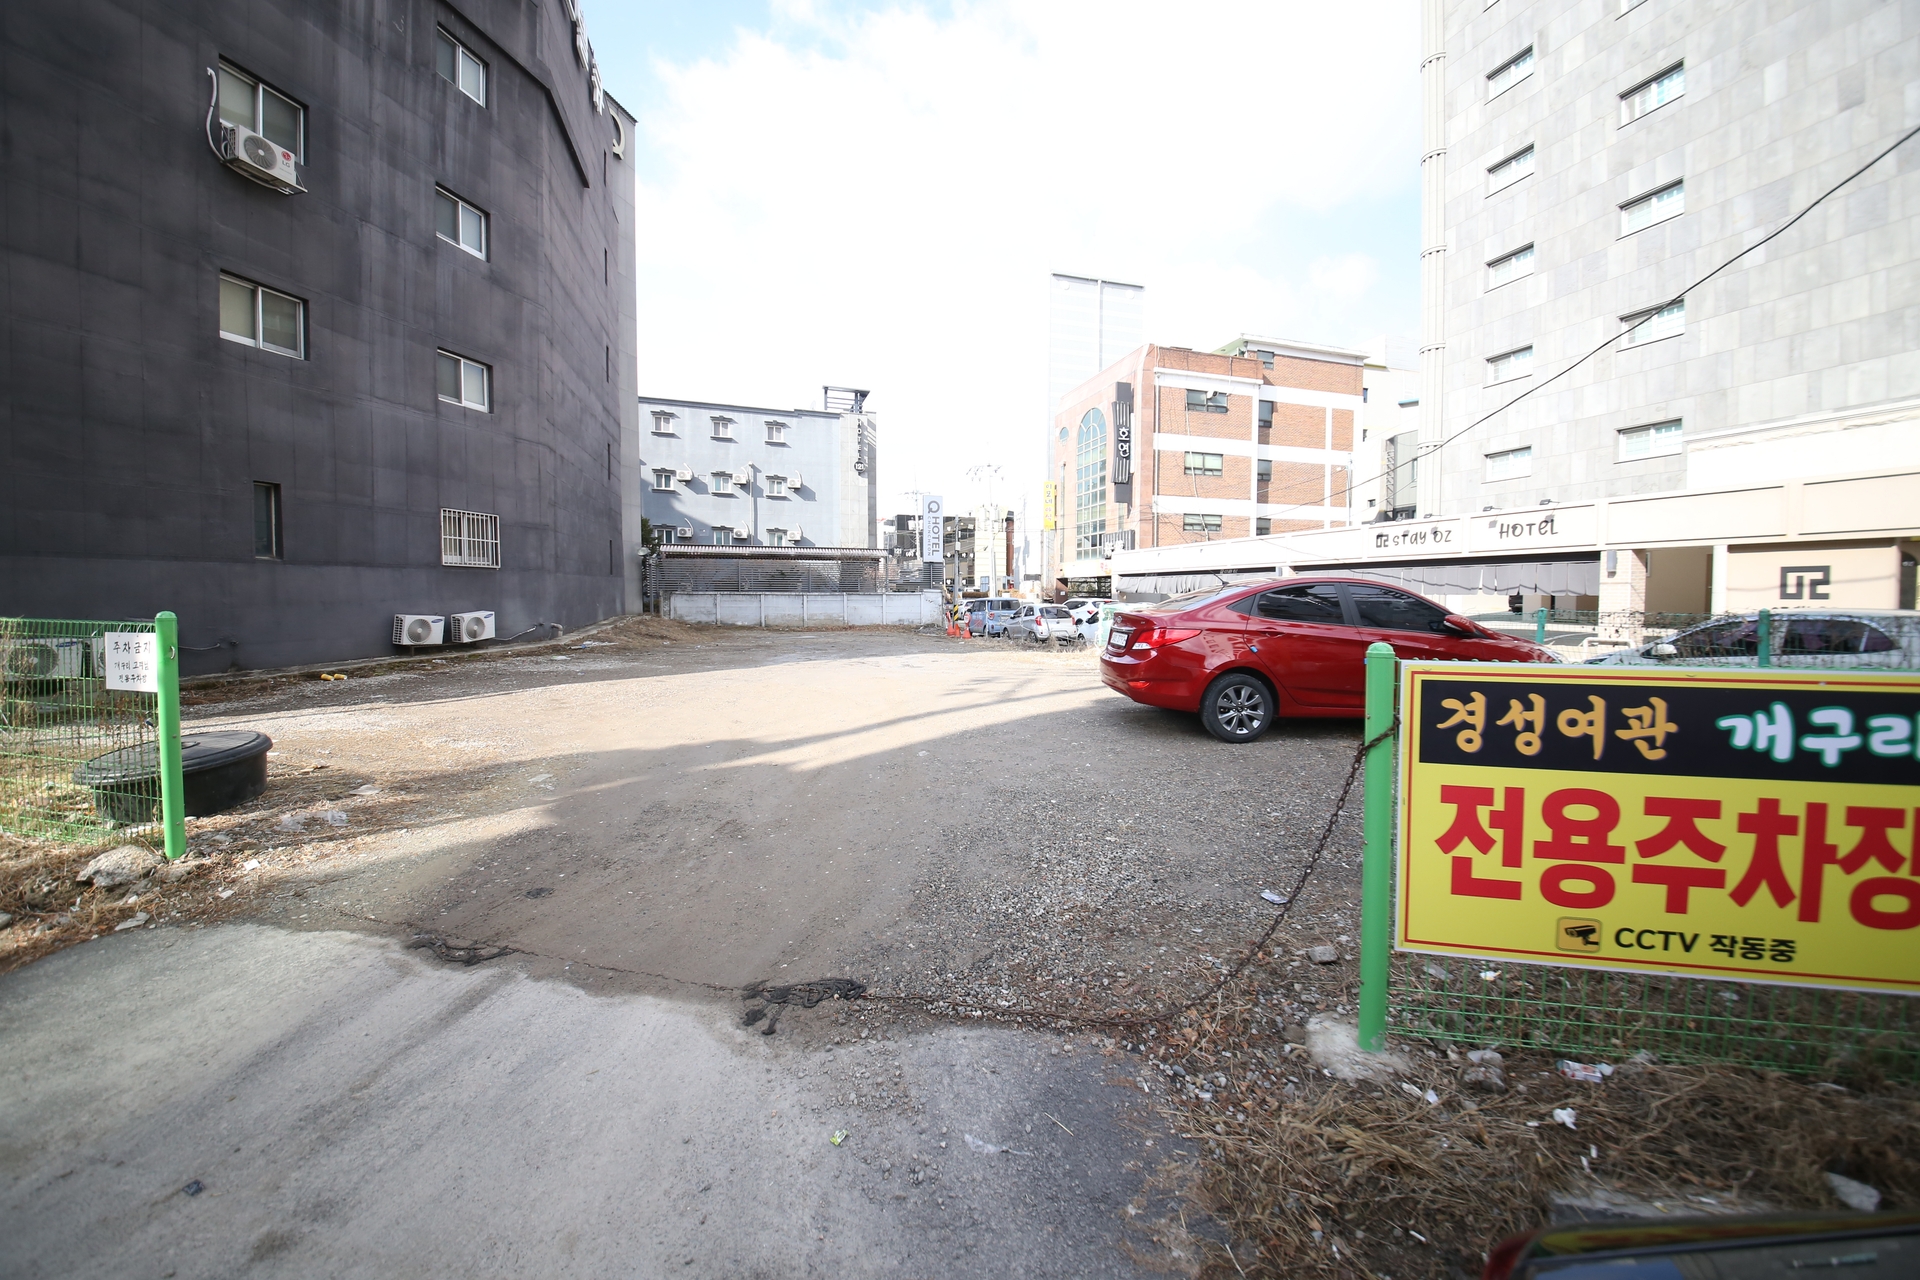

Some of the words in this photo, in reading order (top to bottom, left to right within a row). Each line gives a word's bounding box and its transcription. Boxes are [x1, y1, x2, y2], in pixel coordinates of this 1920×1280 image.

[1118, 427, 1130, 457] 호연
[928, 500, 940, 514] Q
[932, 516, 940, 556] HOTEL
[1436, 691, 1679, 761] 경성여관
[1615, 926, 1699, 954] CCTV
[1709, 933, 1797, 963] 작동중
